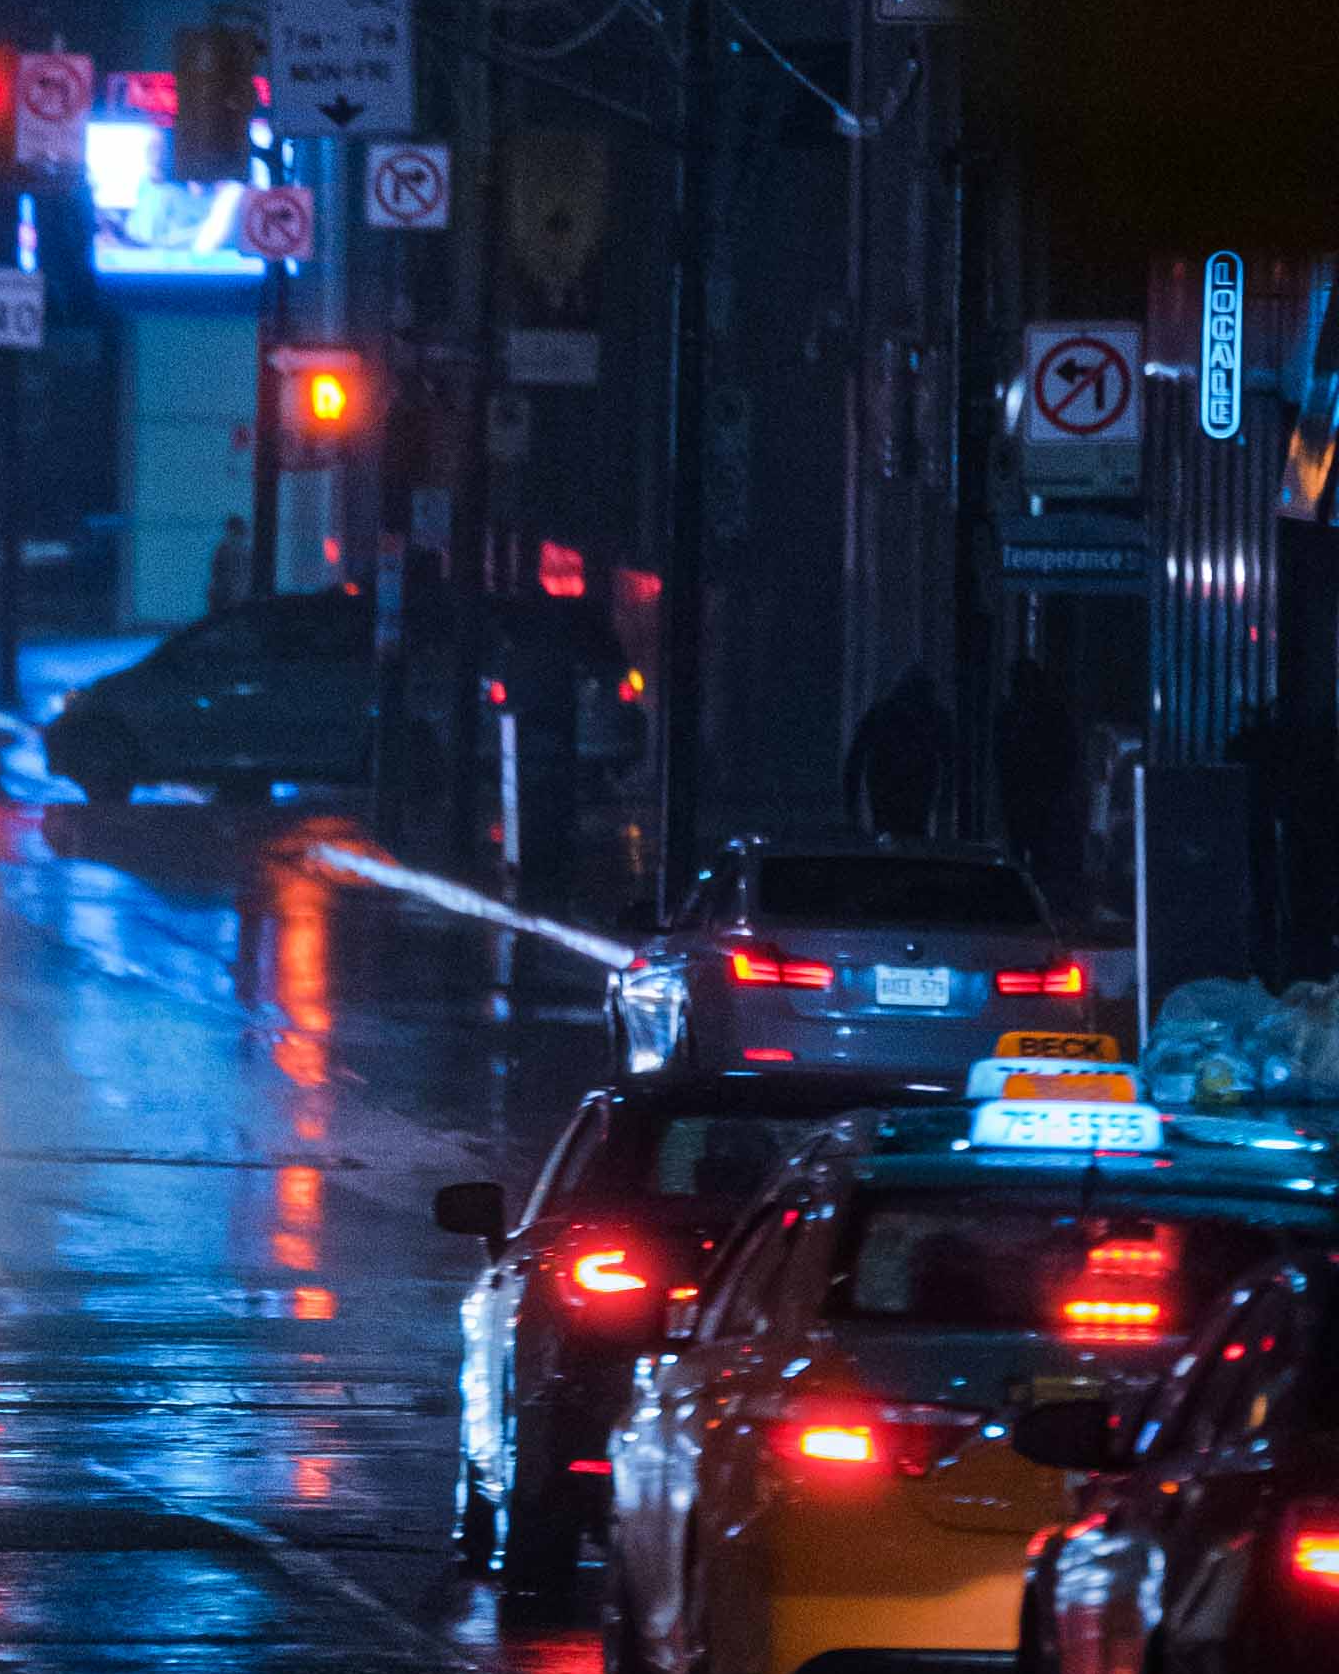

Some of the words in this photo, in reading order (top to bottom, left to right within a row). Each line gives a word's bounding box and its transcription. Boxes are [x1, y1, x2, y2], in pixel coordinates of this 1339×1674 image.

[1209, 261, 1237, 425] LOCALE
[1003, 544, 1122, 574] Temperance
[1018, 1036, 1104, 1058] BECK
[1000, 1109, 1145, 1145] 751-5555
